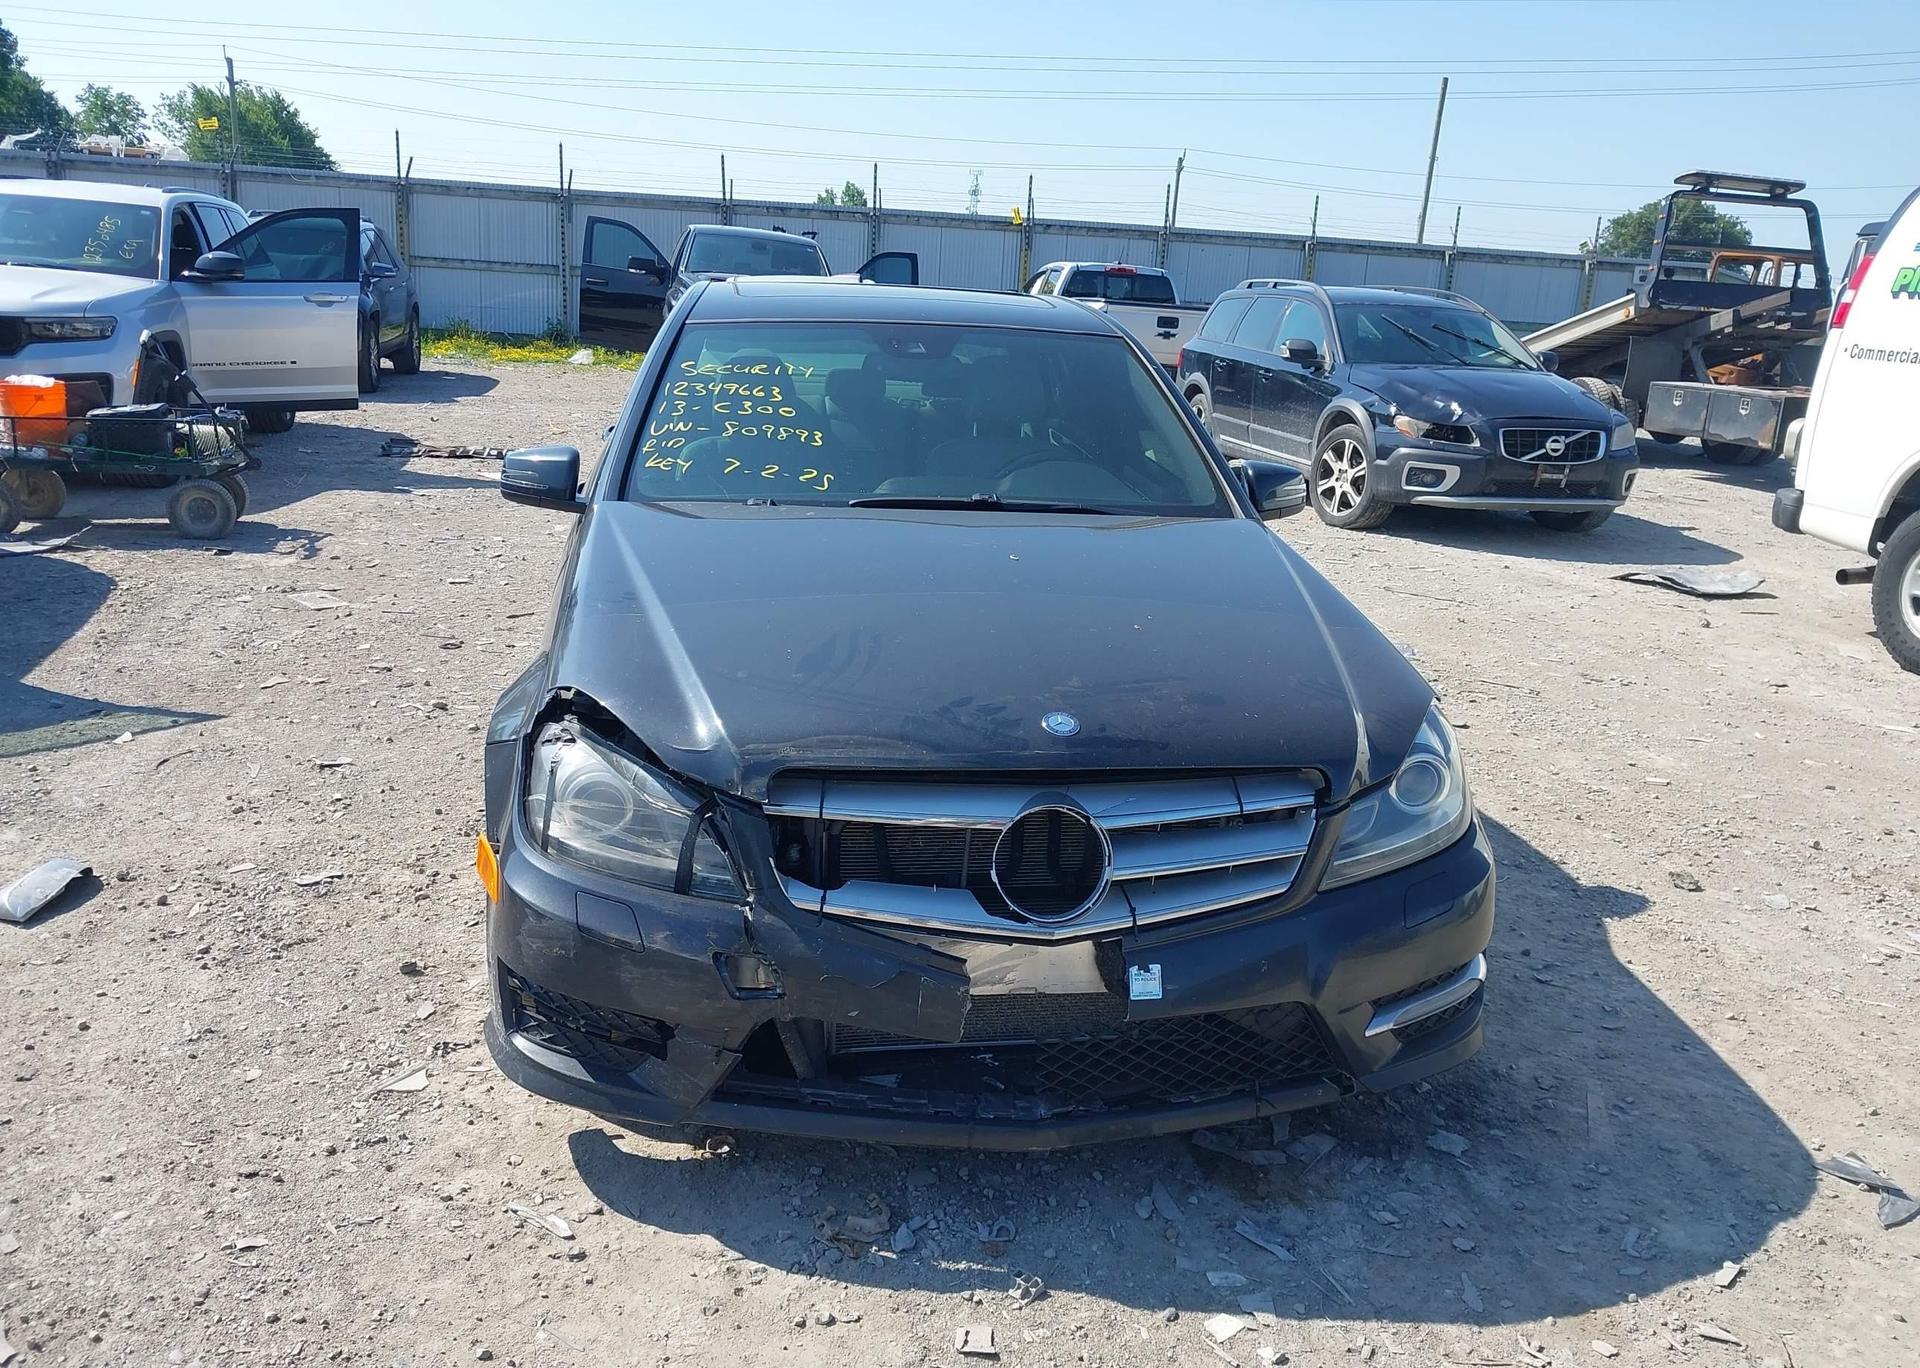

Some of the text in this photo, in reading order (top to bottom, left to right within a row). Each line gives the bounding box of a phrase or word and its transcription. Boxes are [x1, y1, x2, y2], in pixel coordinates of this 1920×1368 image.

[1850, 343, 1920, 365] Commercia
[680, 361, 814, 378] SECURITY
[664, 382, 783, 402] 12349663
[644, 452, 693, 475] KEY
